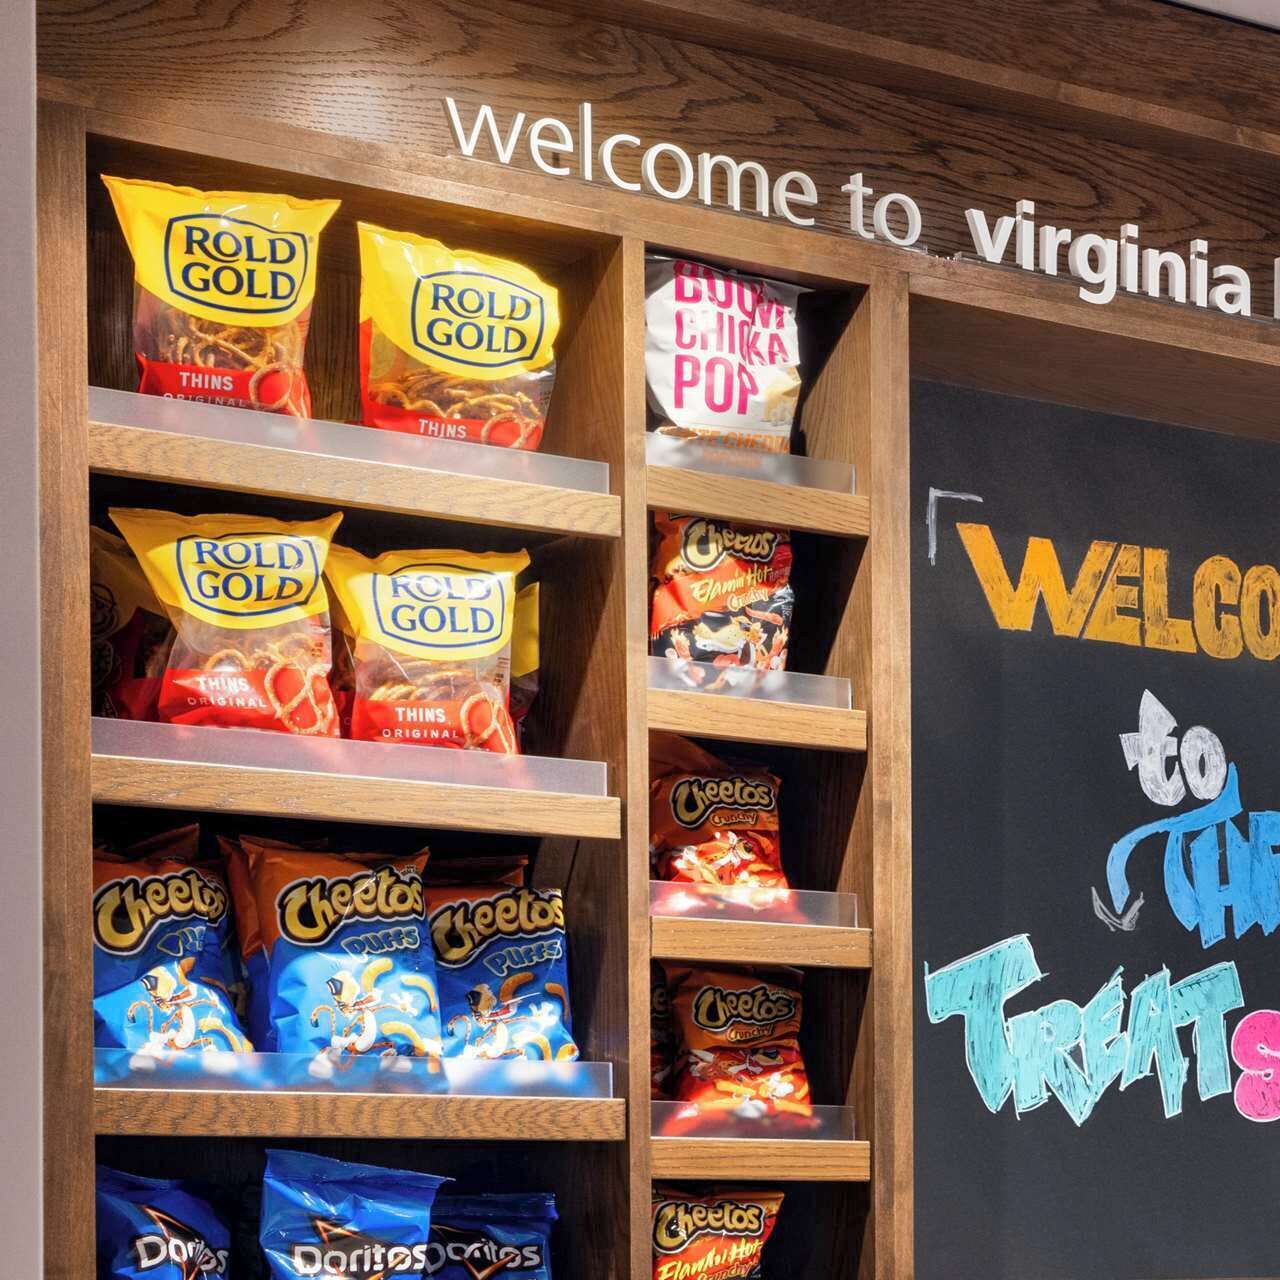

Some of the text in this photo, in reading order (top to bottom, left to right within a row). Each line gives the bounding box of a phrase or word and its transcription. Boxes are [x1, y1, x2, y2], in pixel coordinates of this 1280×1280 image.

[444, 96, 818, 226] welcome
[841, 172, 922, 247] to
[964, 199, 1252, 305] virginia
[183, 223, 297, 266] ROLD
[181, 261, 297, 301] GOLD
[430, 282, 532, 322] ROLD
[426, 318, 528, 354] GOLD
[179, 371, 234, 392] THINS
[673, 354, 759, 416] POP
[418, 418, 467, 439] THINS
[194, 539, 305, 571] ROLD
[196, 571, 304, 602] GOLD
[390, 572, 493, 602] ROLD
[747, 564, 772, 587] Hot
[391, 603, 495, 634] GOLD
[198, 676, 250, 694] THINS
[187, 696, 268, 710] ORIGINAL
[395, 706, 447, 725] THINS
[382, 727, 460, 740] ORIGINAL
[1119, 688, 1227, 806] to
[674, 777, 773, 825] Cheetos
[710, 811, 759, 827] Crunchy
[93, 868, 228, 954] Cheetos
[280, 866, 424, 944] Cheetos
[342, 926, 421, 961] PUFFS
[431, 888, 566, 966] Cheetos
[483, 938, 563, 978] PUFFS
[695, 985, 793, 1030] Cheetos
[727, 1025, 776, 1043] Crunchy
[923, 932, 1246, 1128] TREAT
[654, 1200, 763, 1250] Cheetos
[135, 1232, 231, 1276] Doritos
[292, 1240, 428, 1275] Doritos
[426, 1241, 542, 1275] Doritos
[728, 1238, 764, 1263] Hot
